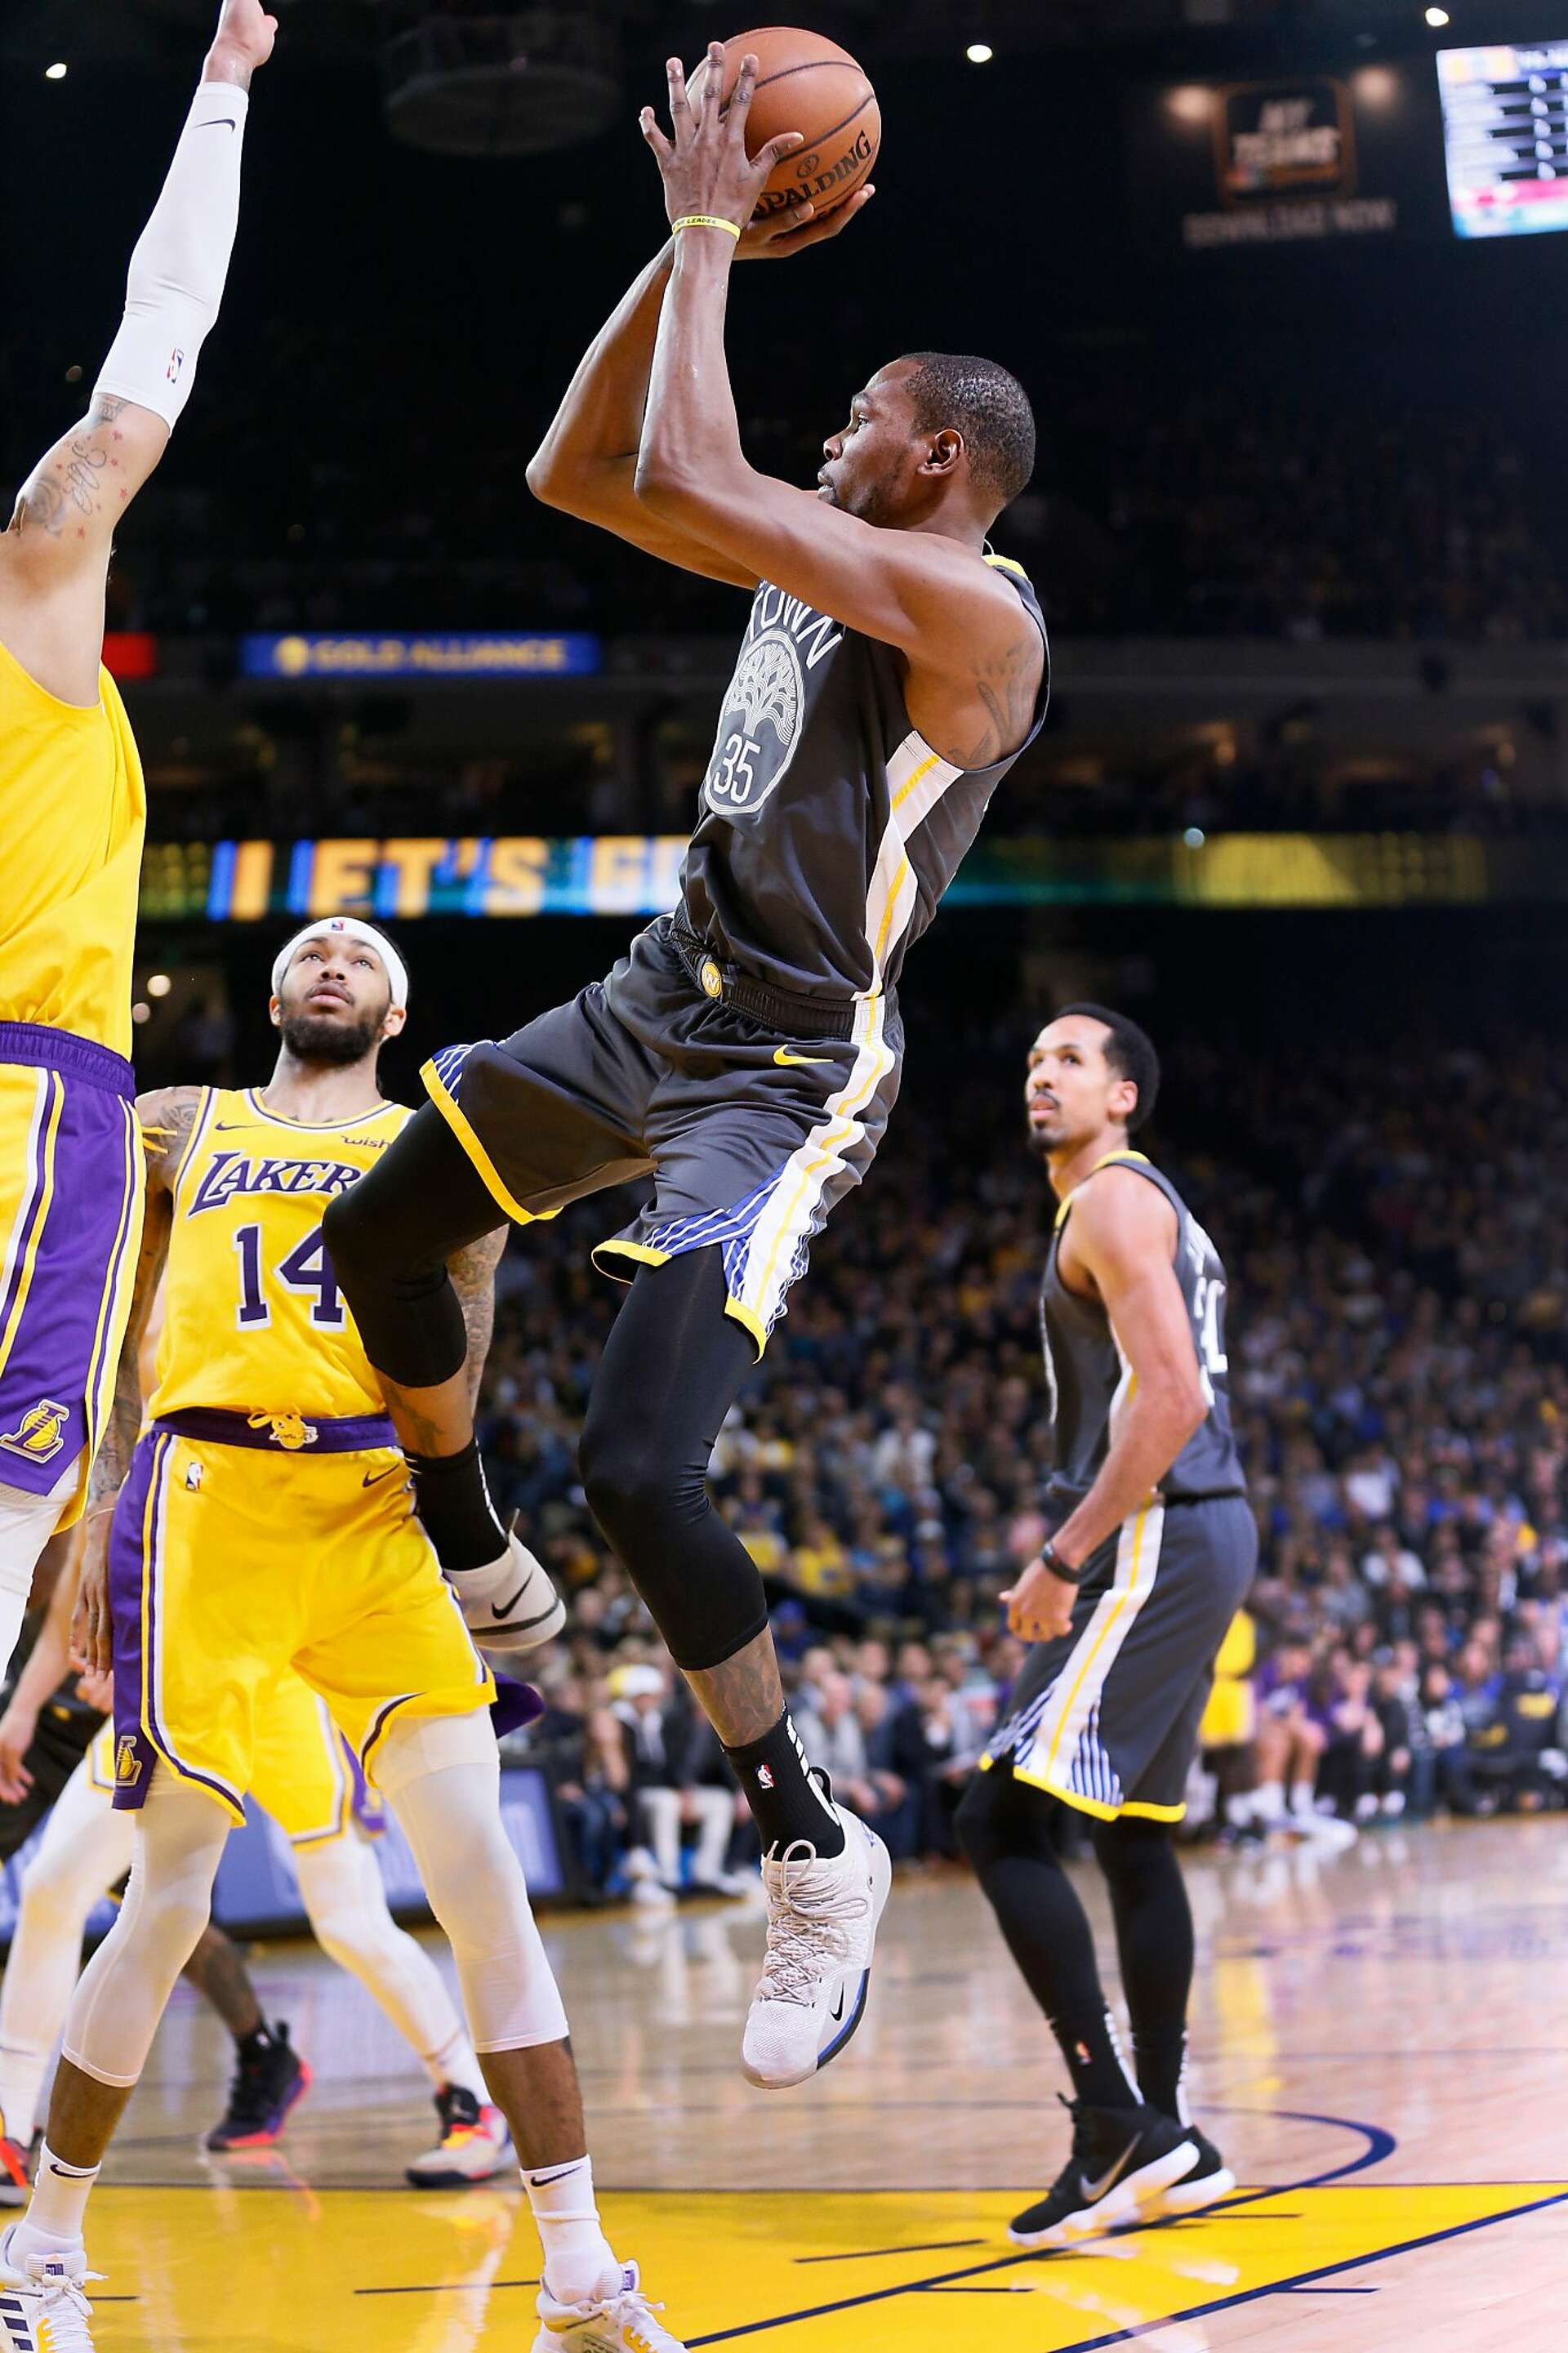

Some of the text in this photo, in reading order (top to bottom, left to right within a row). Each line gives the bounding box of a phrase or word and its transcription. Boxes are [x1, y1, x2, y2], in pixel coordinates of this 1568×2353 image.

[713, 733, 761, 804] 35
[341, 1135, 390, 1148] wish
[234, 1223, 345, 1327] 14
